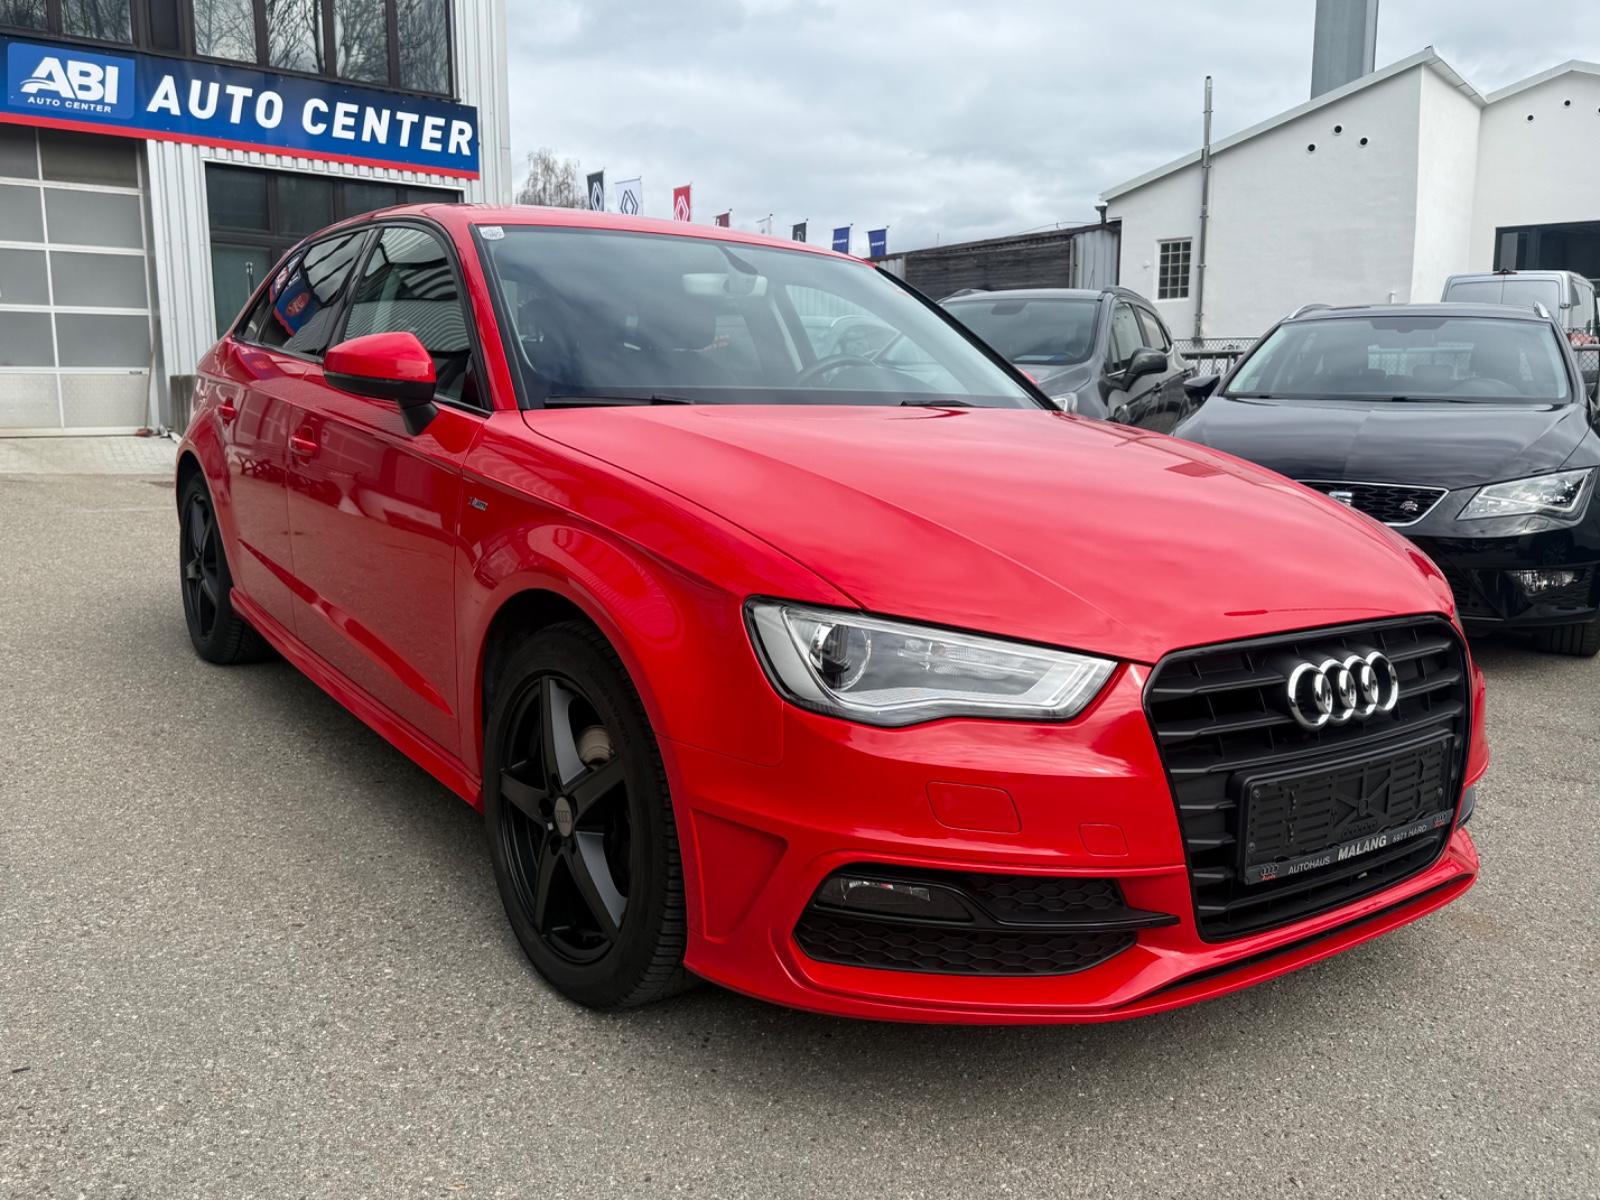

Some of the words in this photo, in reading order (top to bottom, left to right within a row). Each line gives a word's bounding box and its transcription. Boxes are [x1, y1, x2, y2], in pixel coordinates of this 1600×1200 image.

[20, 56, 119, 104] ABI
[27, 96, 61, 107] AUTO
[65, 101, 112, 113] CENTER
[146, 74, 284, 129] AUTO
[301, 98, 473, 156] CENTER
[1288, 856, 1330, 875] AUTOHAUS
[1337, 835, 1387, 861] MALANG
[1408, 824, 1427, 837] HARD
